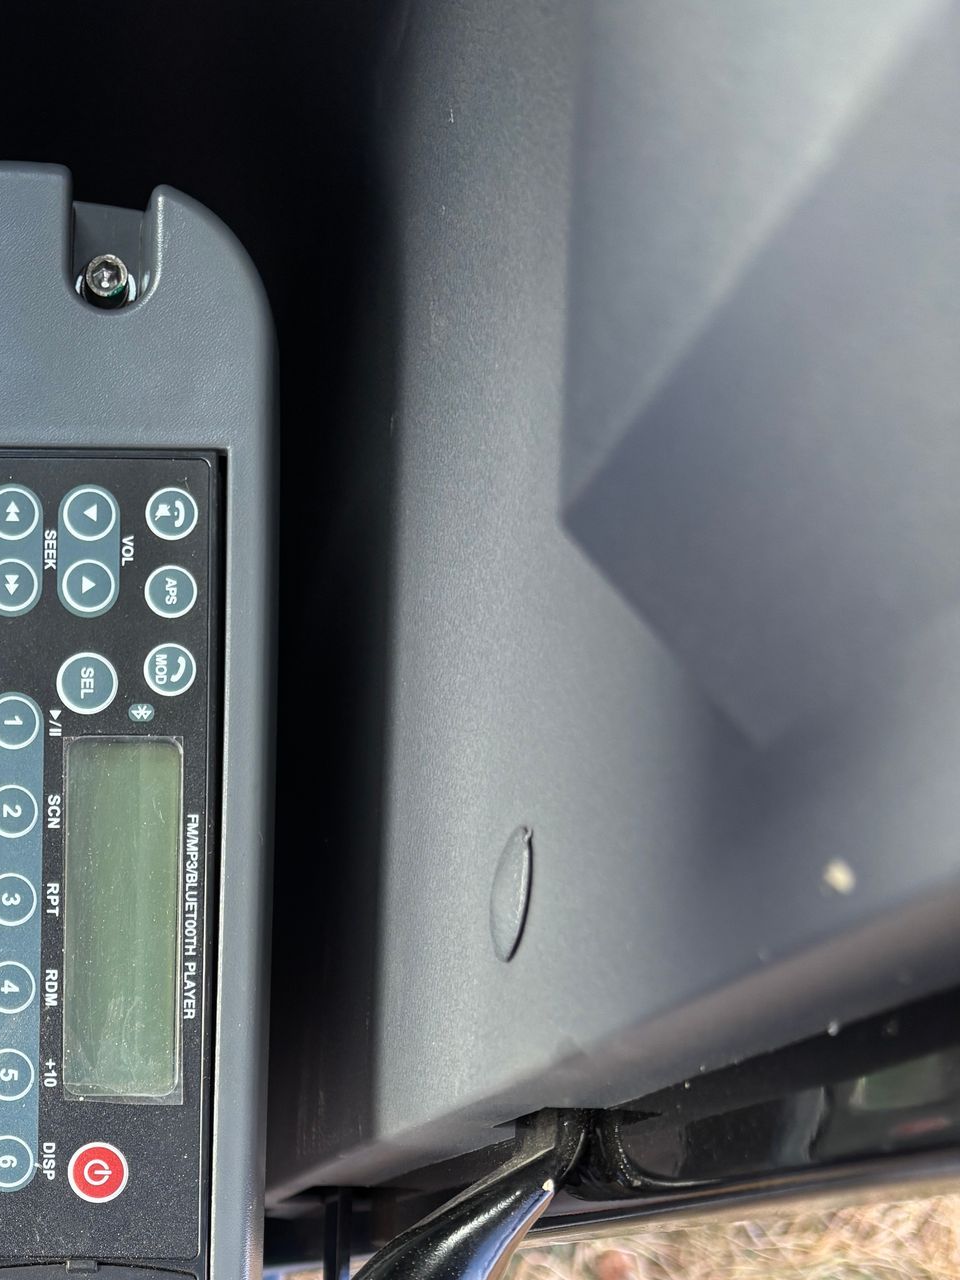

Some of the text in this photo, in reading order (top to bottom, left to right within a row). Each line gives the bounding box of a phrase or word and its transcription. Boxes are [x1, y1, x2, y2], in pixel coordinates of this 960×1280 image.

[44, 529, 57, 570] SEEK
[121, 535, 135, 567] VOL
[165, 577, 178, 605] APS
[80, 666, 95, 699] SEL
[155, 654, 168, 685] MOD
[3, 715, 23, 726] 1
[2, 803, 22, 818] 2
[47, 794, 61, 829] SCN
[1, 892, 21, 906] 3
[46, 882, 60, 917] RPT
[0, 979, 20, 995] 4
[44, 969, 59, 1007] RDM
[182, 961, 197, 1020] PLAYER
[0, 1067, 19, 1082] 5
[43, 1058, 58, 1088] +10
[42, 1142, 56, 1181] DISP
